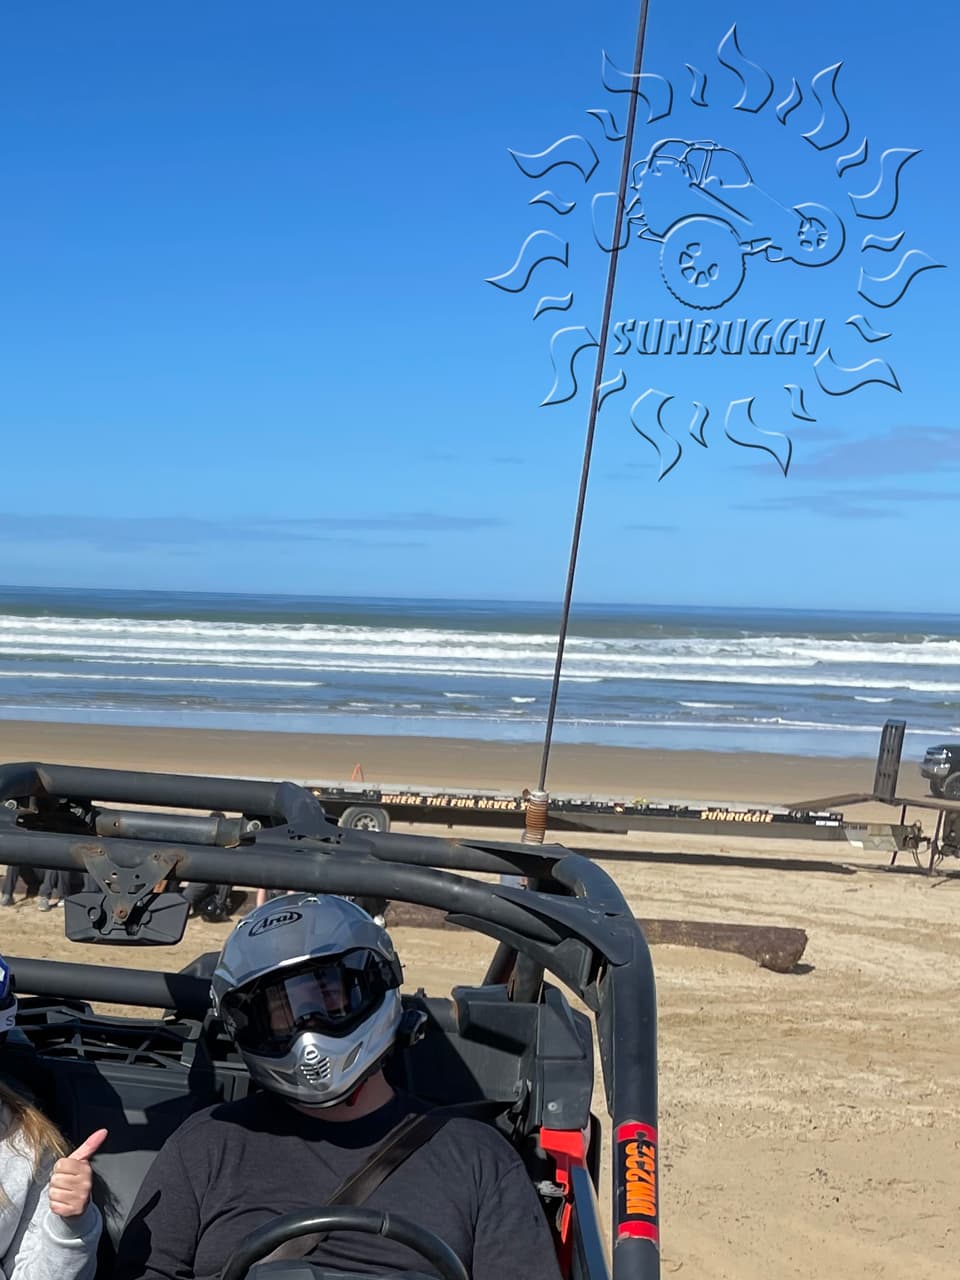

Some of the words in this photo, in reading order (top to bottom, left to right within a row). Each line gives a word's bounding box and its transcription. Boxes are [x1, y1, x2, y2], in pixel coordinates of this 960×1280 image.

[381, 794, 422, 805] WHERE
[426, 796, 449, 806] THE
[450, 798, 475, 808] FUN
[478, 799, 517, 810] NEVER
[701, 810, 774, 823] SUNBUGGIE
[253, 911, 298, 933] Arai
